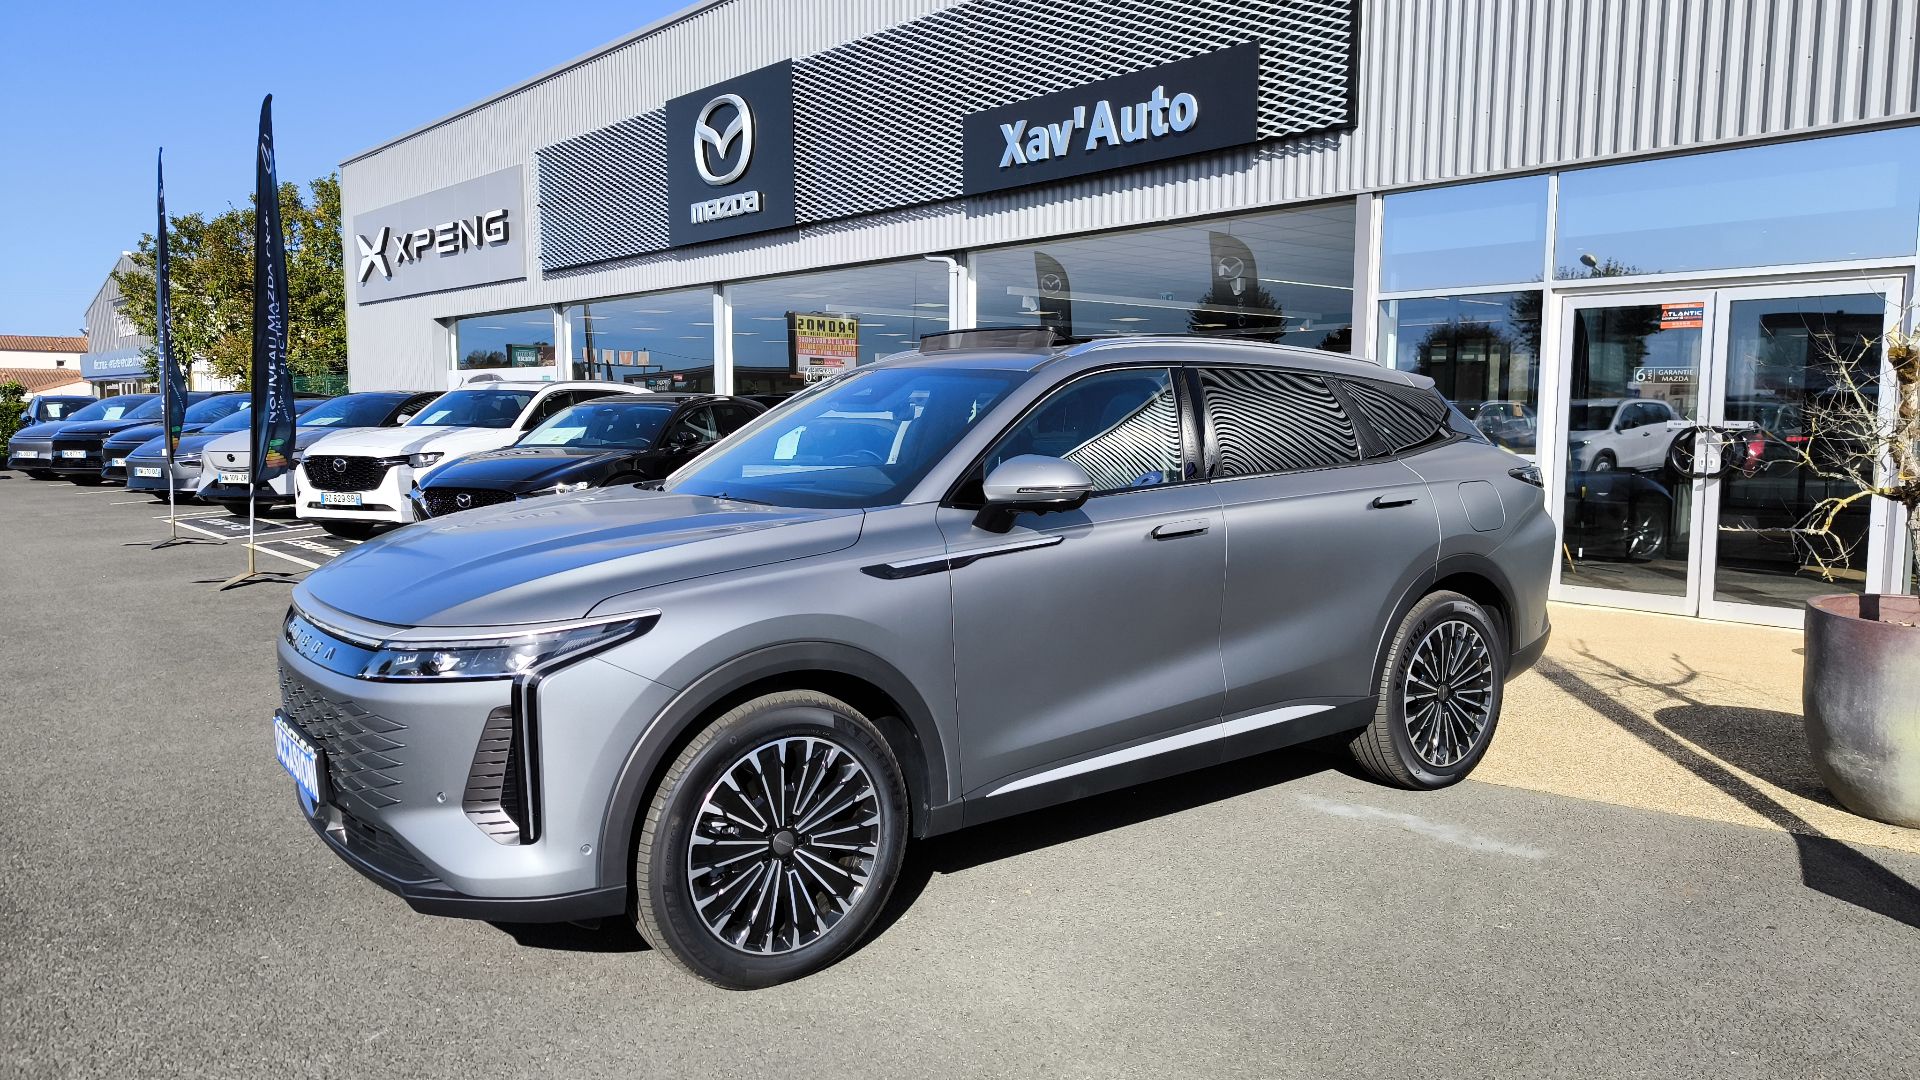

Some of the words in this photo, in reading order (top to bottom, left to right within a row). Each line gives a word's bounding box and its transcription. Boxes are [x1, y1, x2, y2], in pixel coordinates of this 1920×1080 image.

[999, 84, 1199, 168] Xav'Auto
[690, 190, 760, 224] mazda
[393, 208, 510, 264] XPENG
[1661, 309, 1703, 317] ATLANTIC
[1636, 368, 1646, 382] 6
